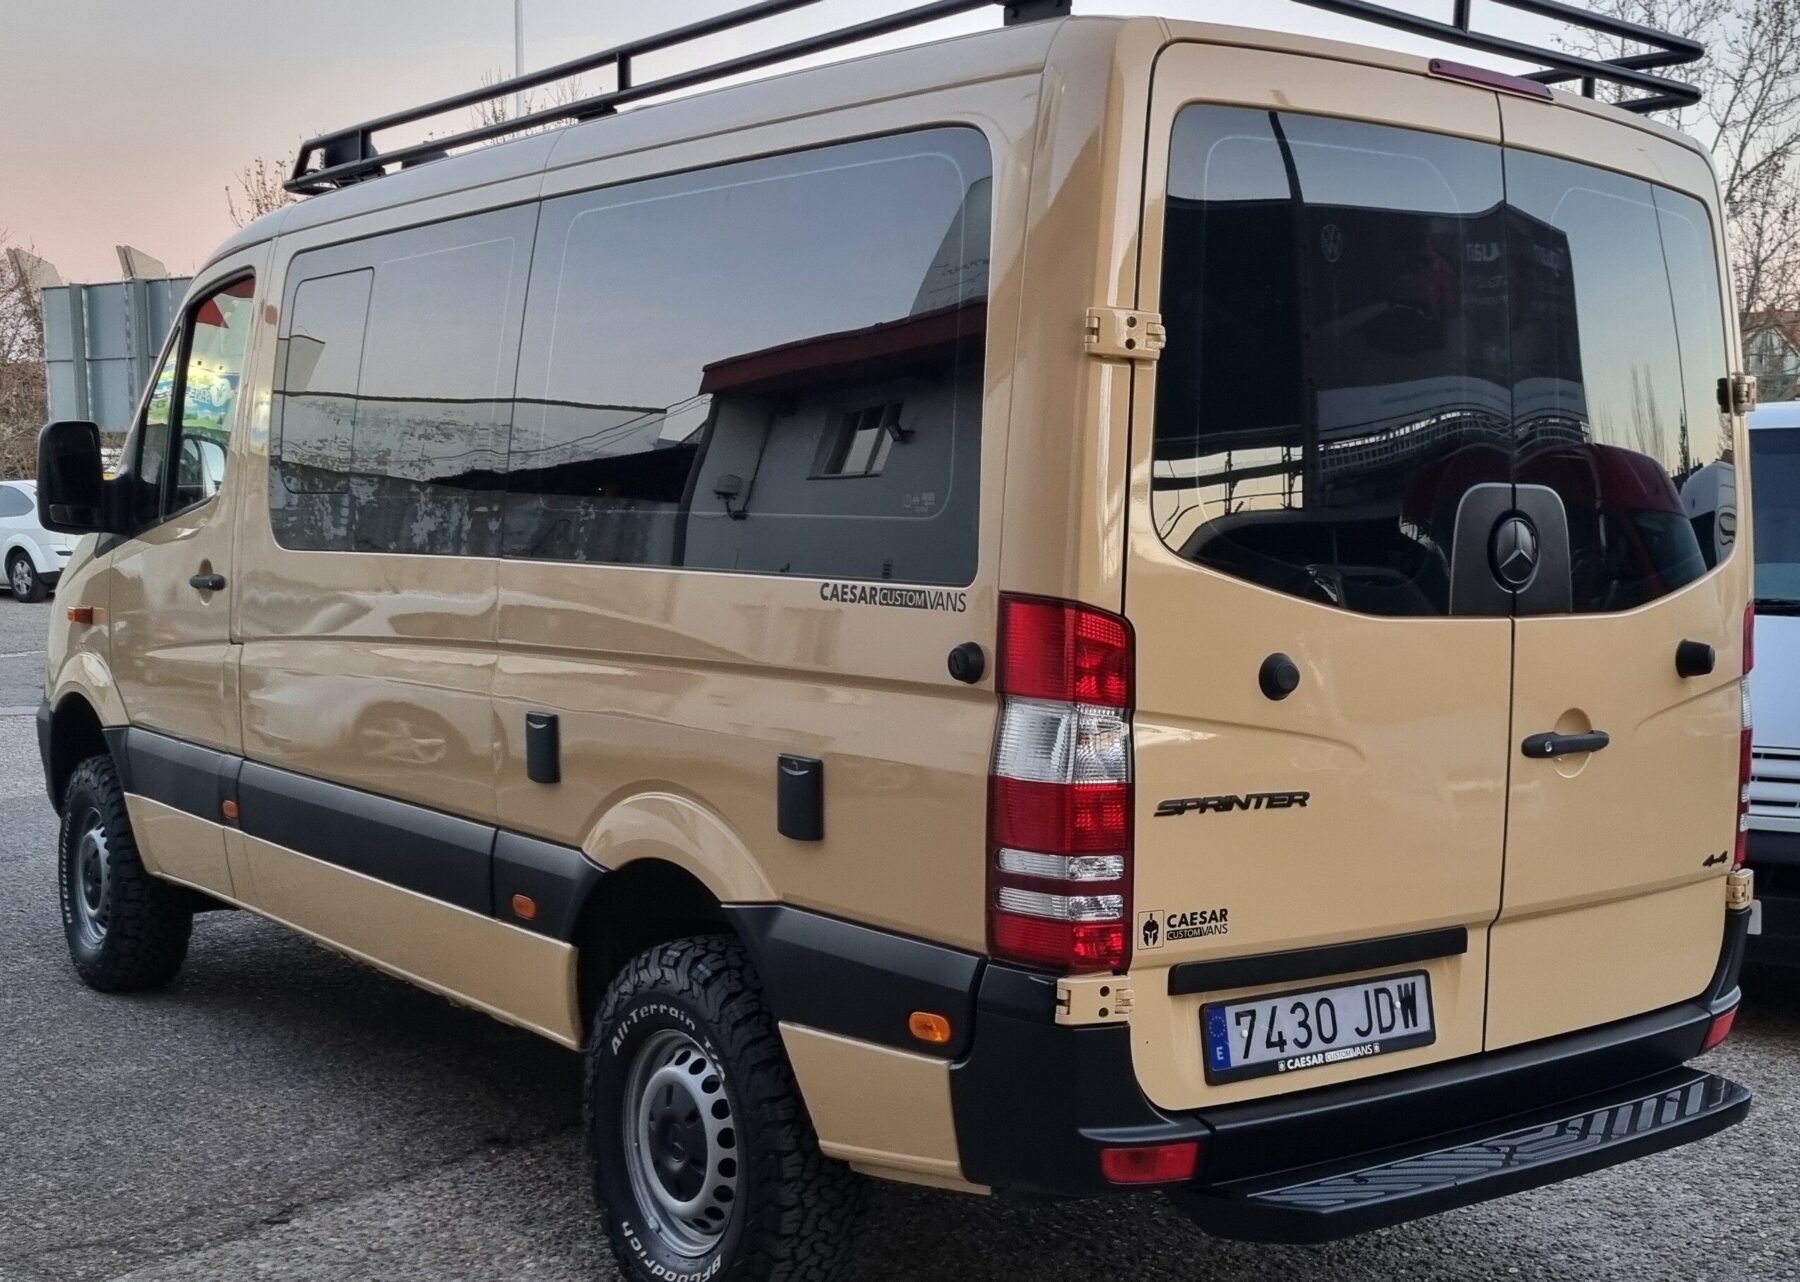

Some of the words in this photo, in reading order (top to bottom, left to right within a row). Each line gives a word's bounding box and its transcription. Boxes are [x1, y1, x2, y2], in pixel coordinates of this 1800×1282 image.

[1153, 791, 1311, 817] SPRINTER
[1166, 908, 1228, 928] CAESAR
[1234, 997, 1338, 1059] 7430
[1354, 981, 1419, 1038] JDW
[1216, 1046, 1224, 1061] E
[1287, 1053, 1324, 1070] CAESAR
